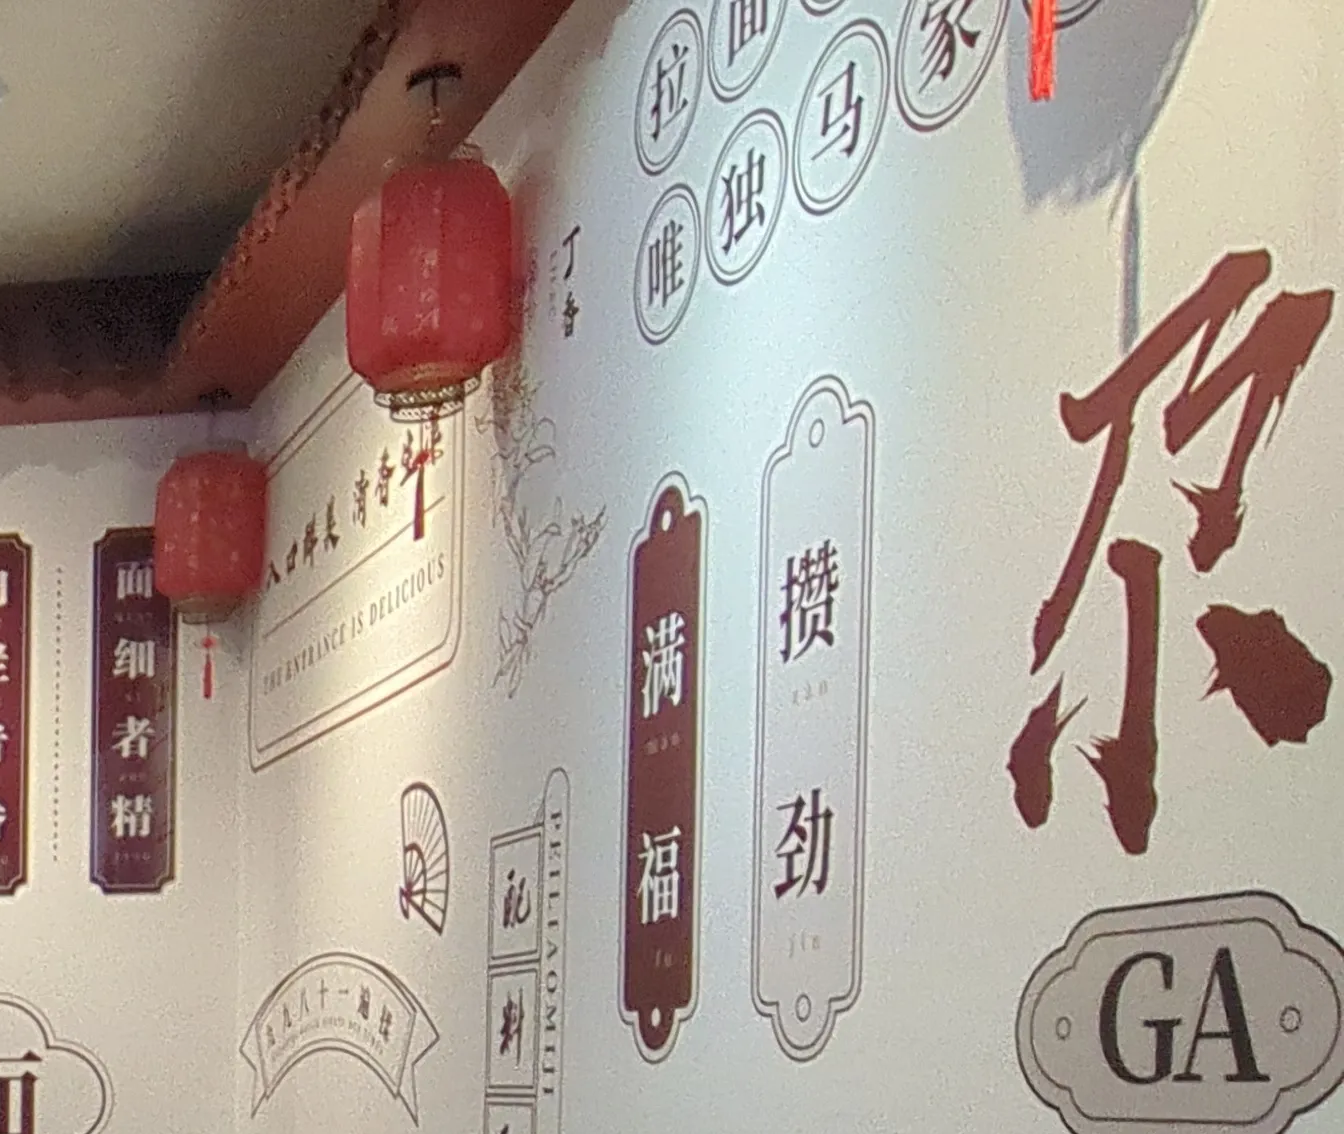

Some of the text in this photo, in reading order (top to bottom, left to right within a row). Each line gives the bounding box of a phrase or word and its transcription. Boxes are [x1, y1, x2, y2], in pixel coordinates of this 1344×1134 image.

[562, 225, 580, 337] 丁香
[111, 560, 156, 838] 面细者精
[351, 614, 364, 639] IS
[369, 552, 446, 626] DELICIOUS
[637, 611, 686, 926] 满福
[775, 539, 839, 900] 攒劲
[1099, 947, 1272, 1086] GA
